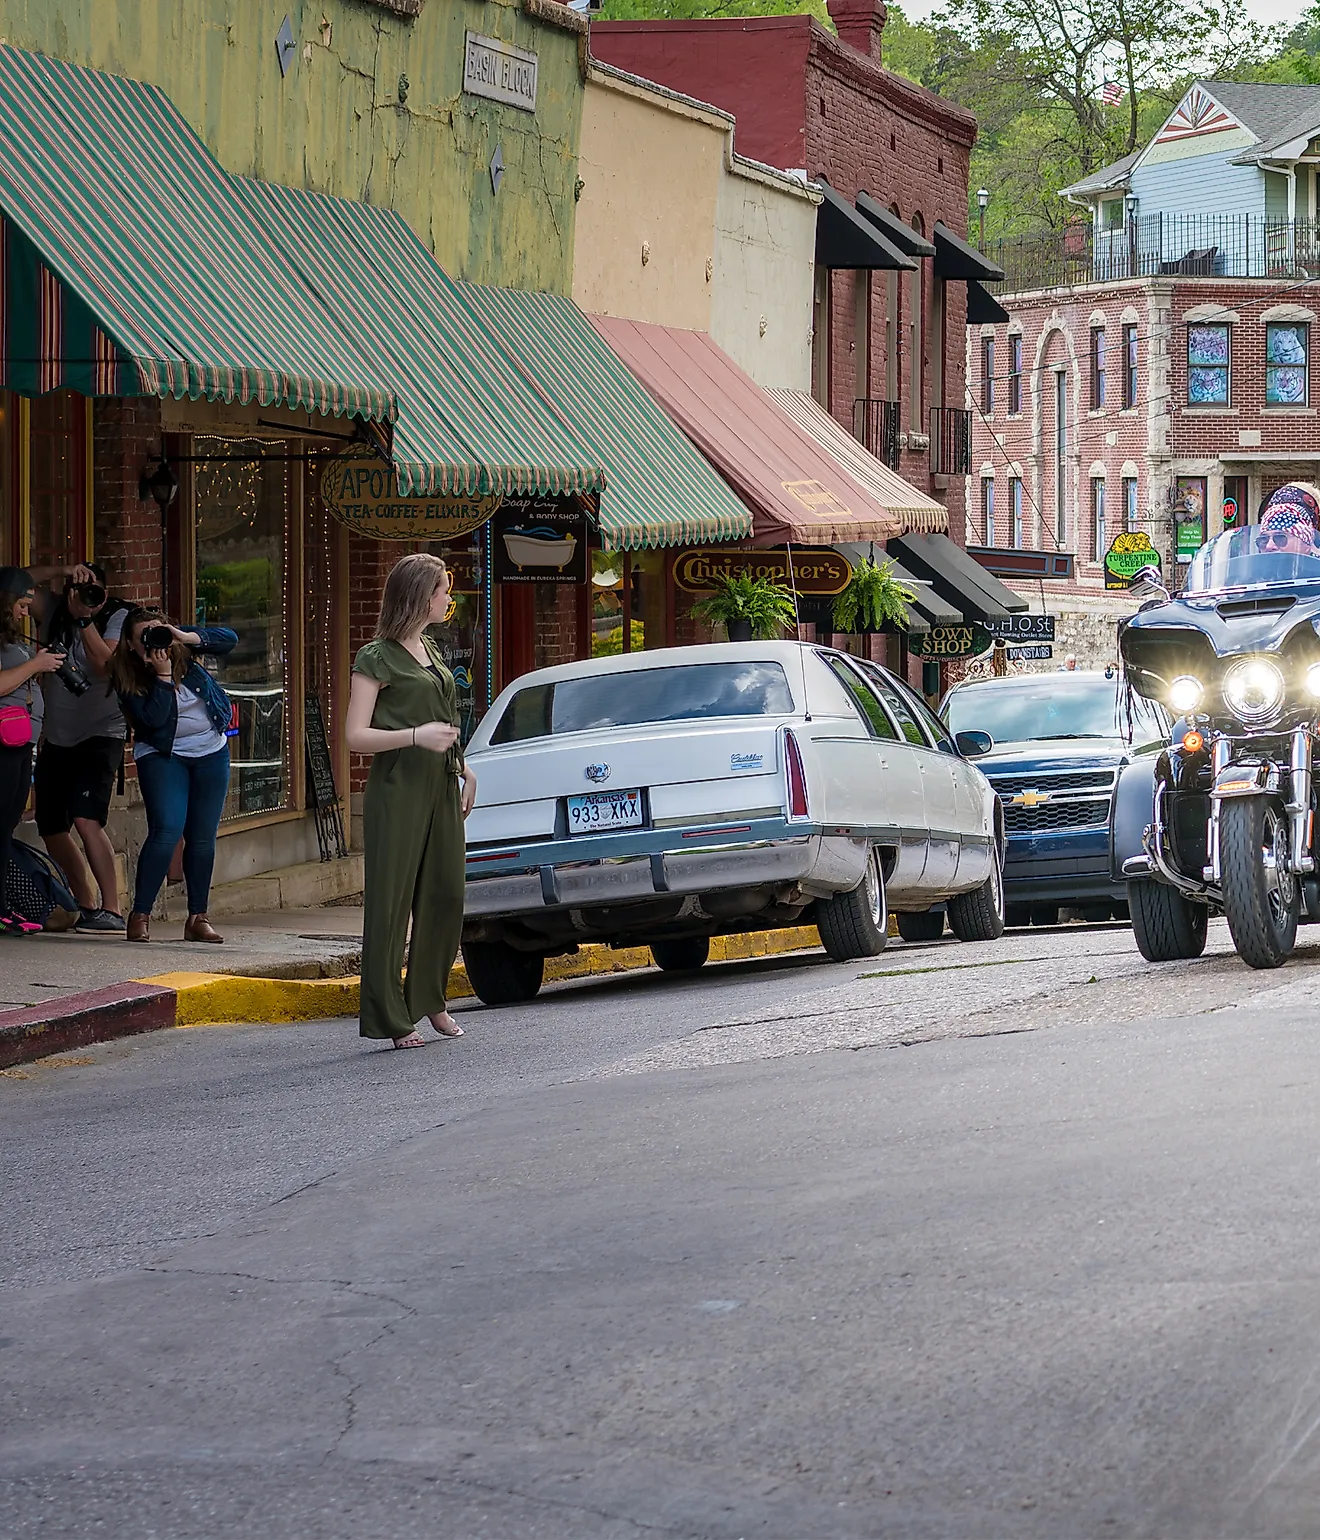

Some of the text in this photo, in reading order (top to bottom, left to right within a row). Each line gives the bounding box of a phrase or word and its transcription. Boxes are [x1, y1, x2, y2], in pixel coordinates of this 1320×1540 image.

[466, 47, 535, 101] BASIN BLOCK
[1108, 553, 1157, 562] TURPENTINE
[1119, 560, 1146, 568] CREEK
[683, 554, 841, 586] Christopher's
[922, 640, 972, 654] SHOP
[585, 793, 625, 806] Arkansas
[572, 799, 638, 824] 933 XKX
